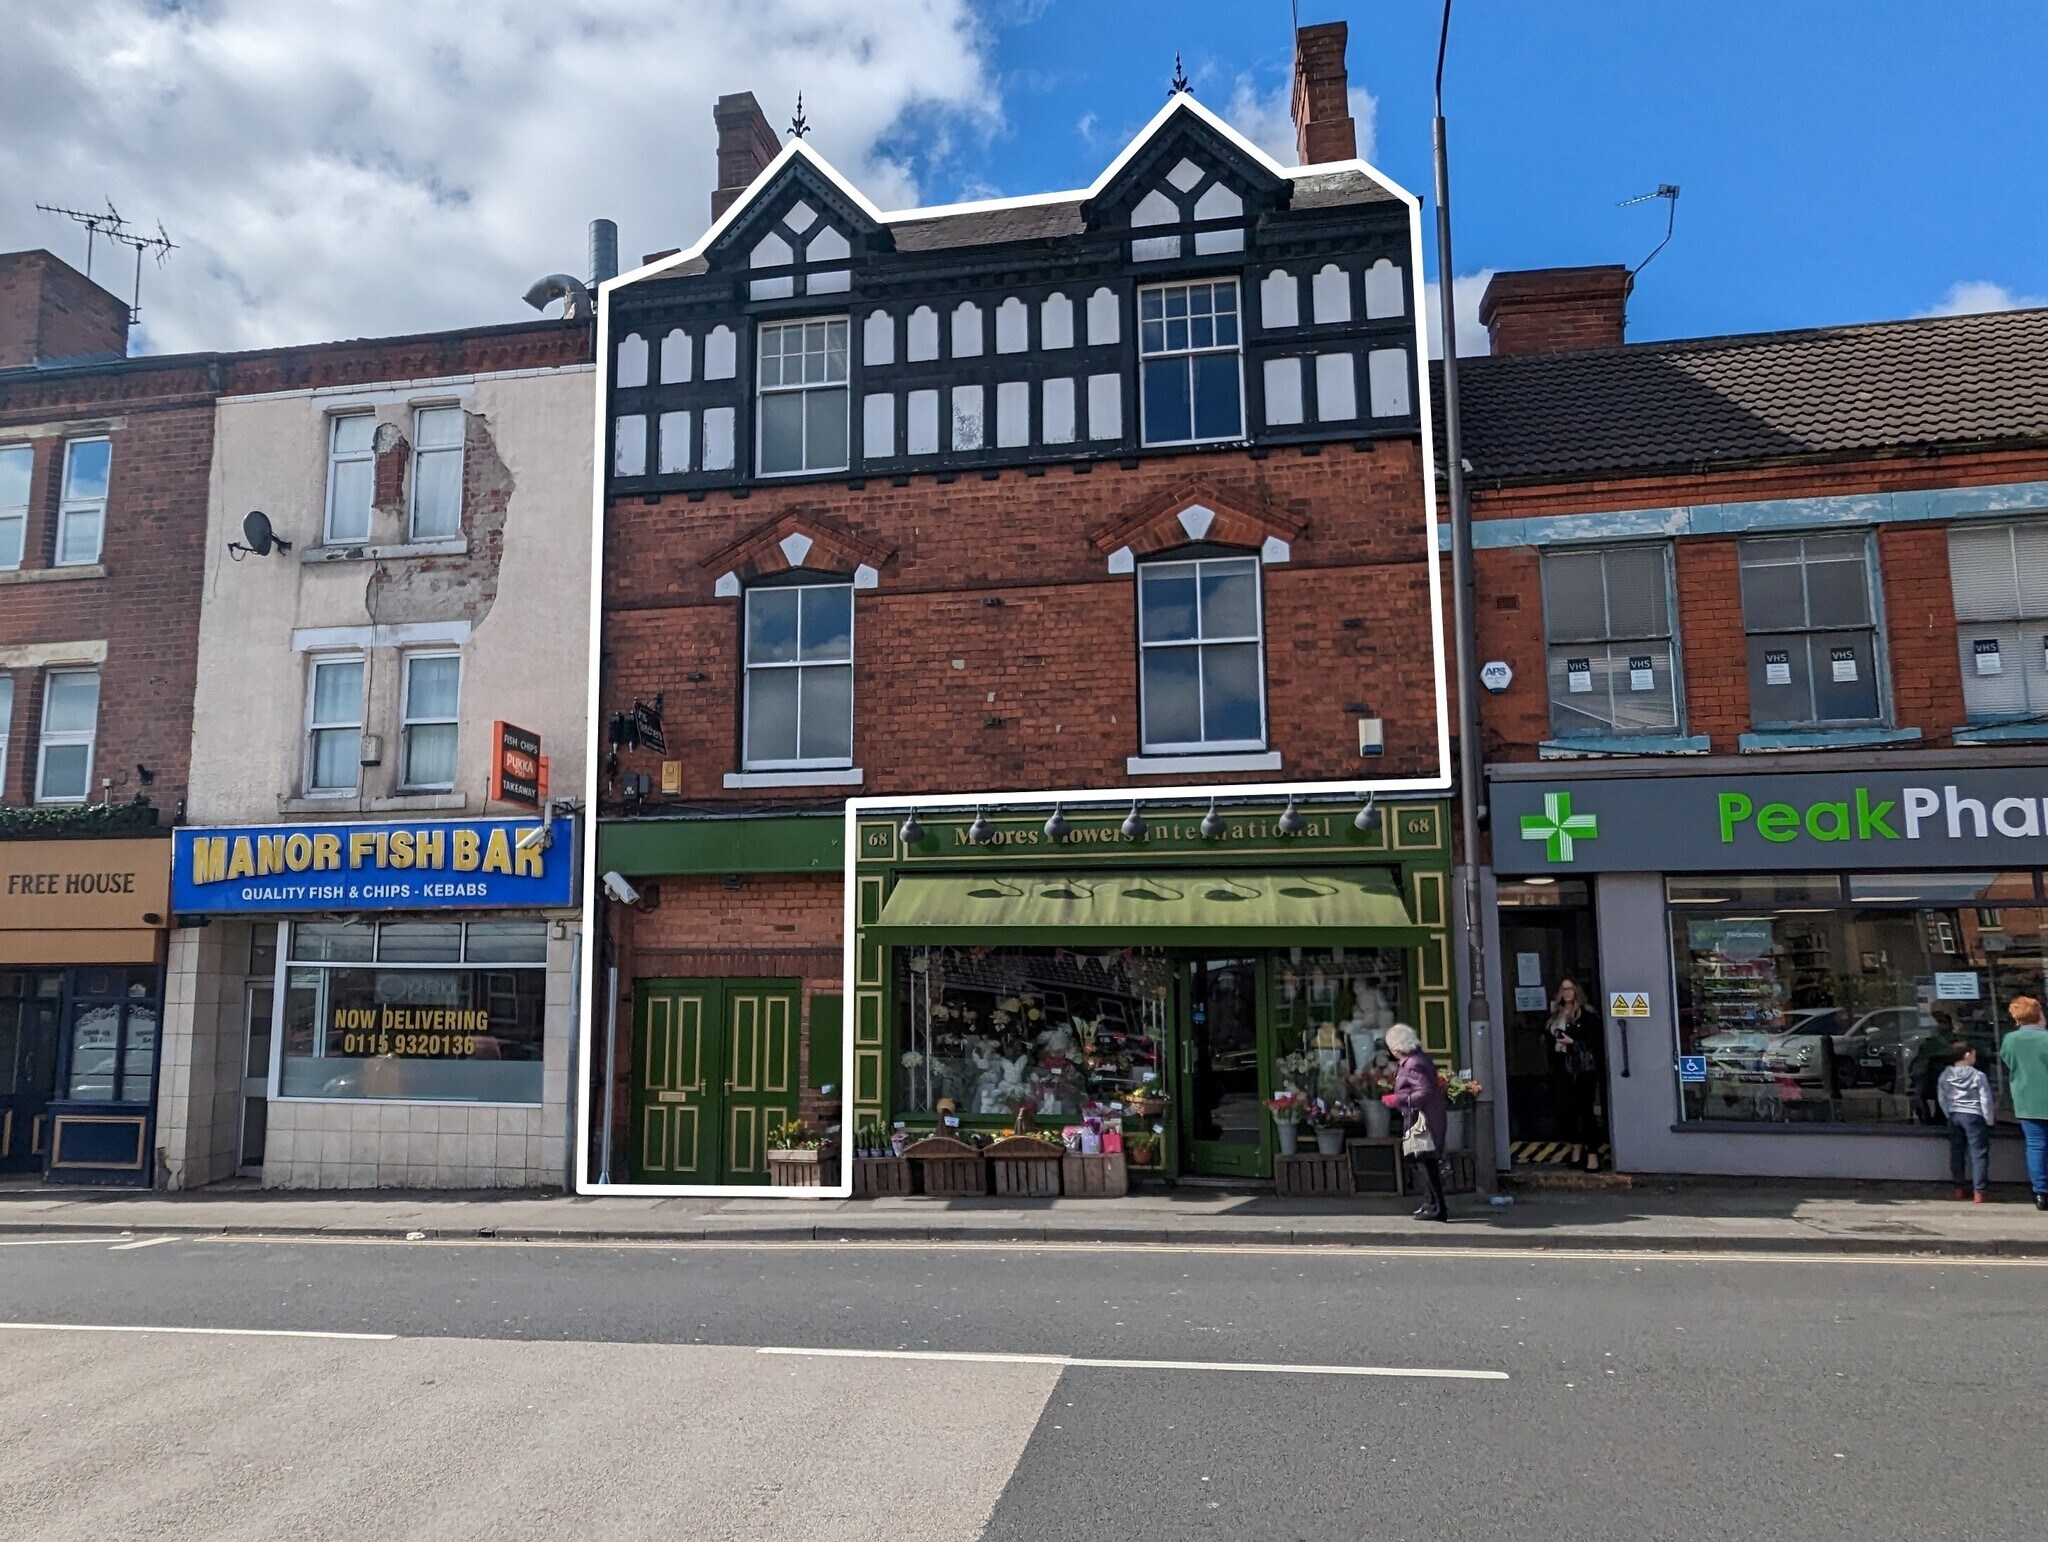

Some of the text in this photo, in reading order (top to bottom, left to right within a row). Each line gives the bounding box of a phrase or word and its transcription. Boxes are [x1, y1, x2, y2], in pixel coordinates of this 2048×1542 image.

[1832, 650, 1853, 659] VHS
[1976, 643, 1997, 652] VHS
[1569, 662, 1588, 671] VHS
[1630, 659, 1650, 668] VHS
[1766, 653, 1787, 662] VHS
[504, 734, 538, 754] FISH CHIPS
[506, 752, 534, 774] PUKKA
[503, 780, 536, 798] TAKEAWAY
[868, 832, 888, 846] 68
[955, 827, 1039, 845] Mores
[1408, 818, 1430, 833] 68
[193, 828, 544, 885] MANOR FISH BAR
[8, 872, 135, 894] FREE HOUSE
[242, 887, 306, 901] QUALITY
[309, 886, 344, 899] FISH
[349, 886, 359, 899] &
[363, 885, 410, 898] CHIPS
[423, 883, 487, 897] KEBABS
[335, 1009, 489, 1030] NOW DELIVERING
[344, 1034, 475, 1055] 0115 9320136
